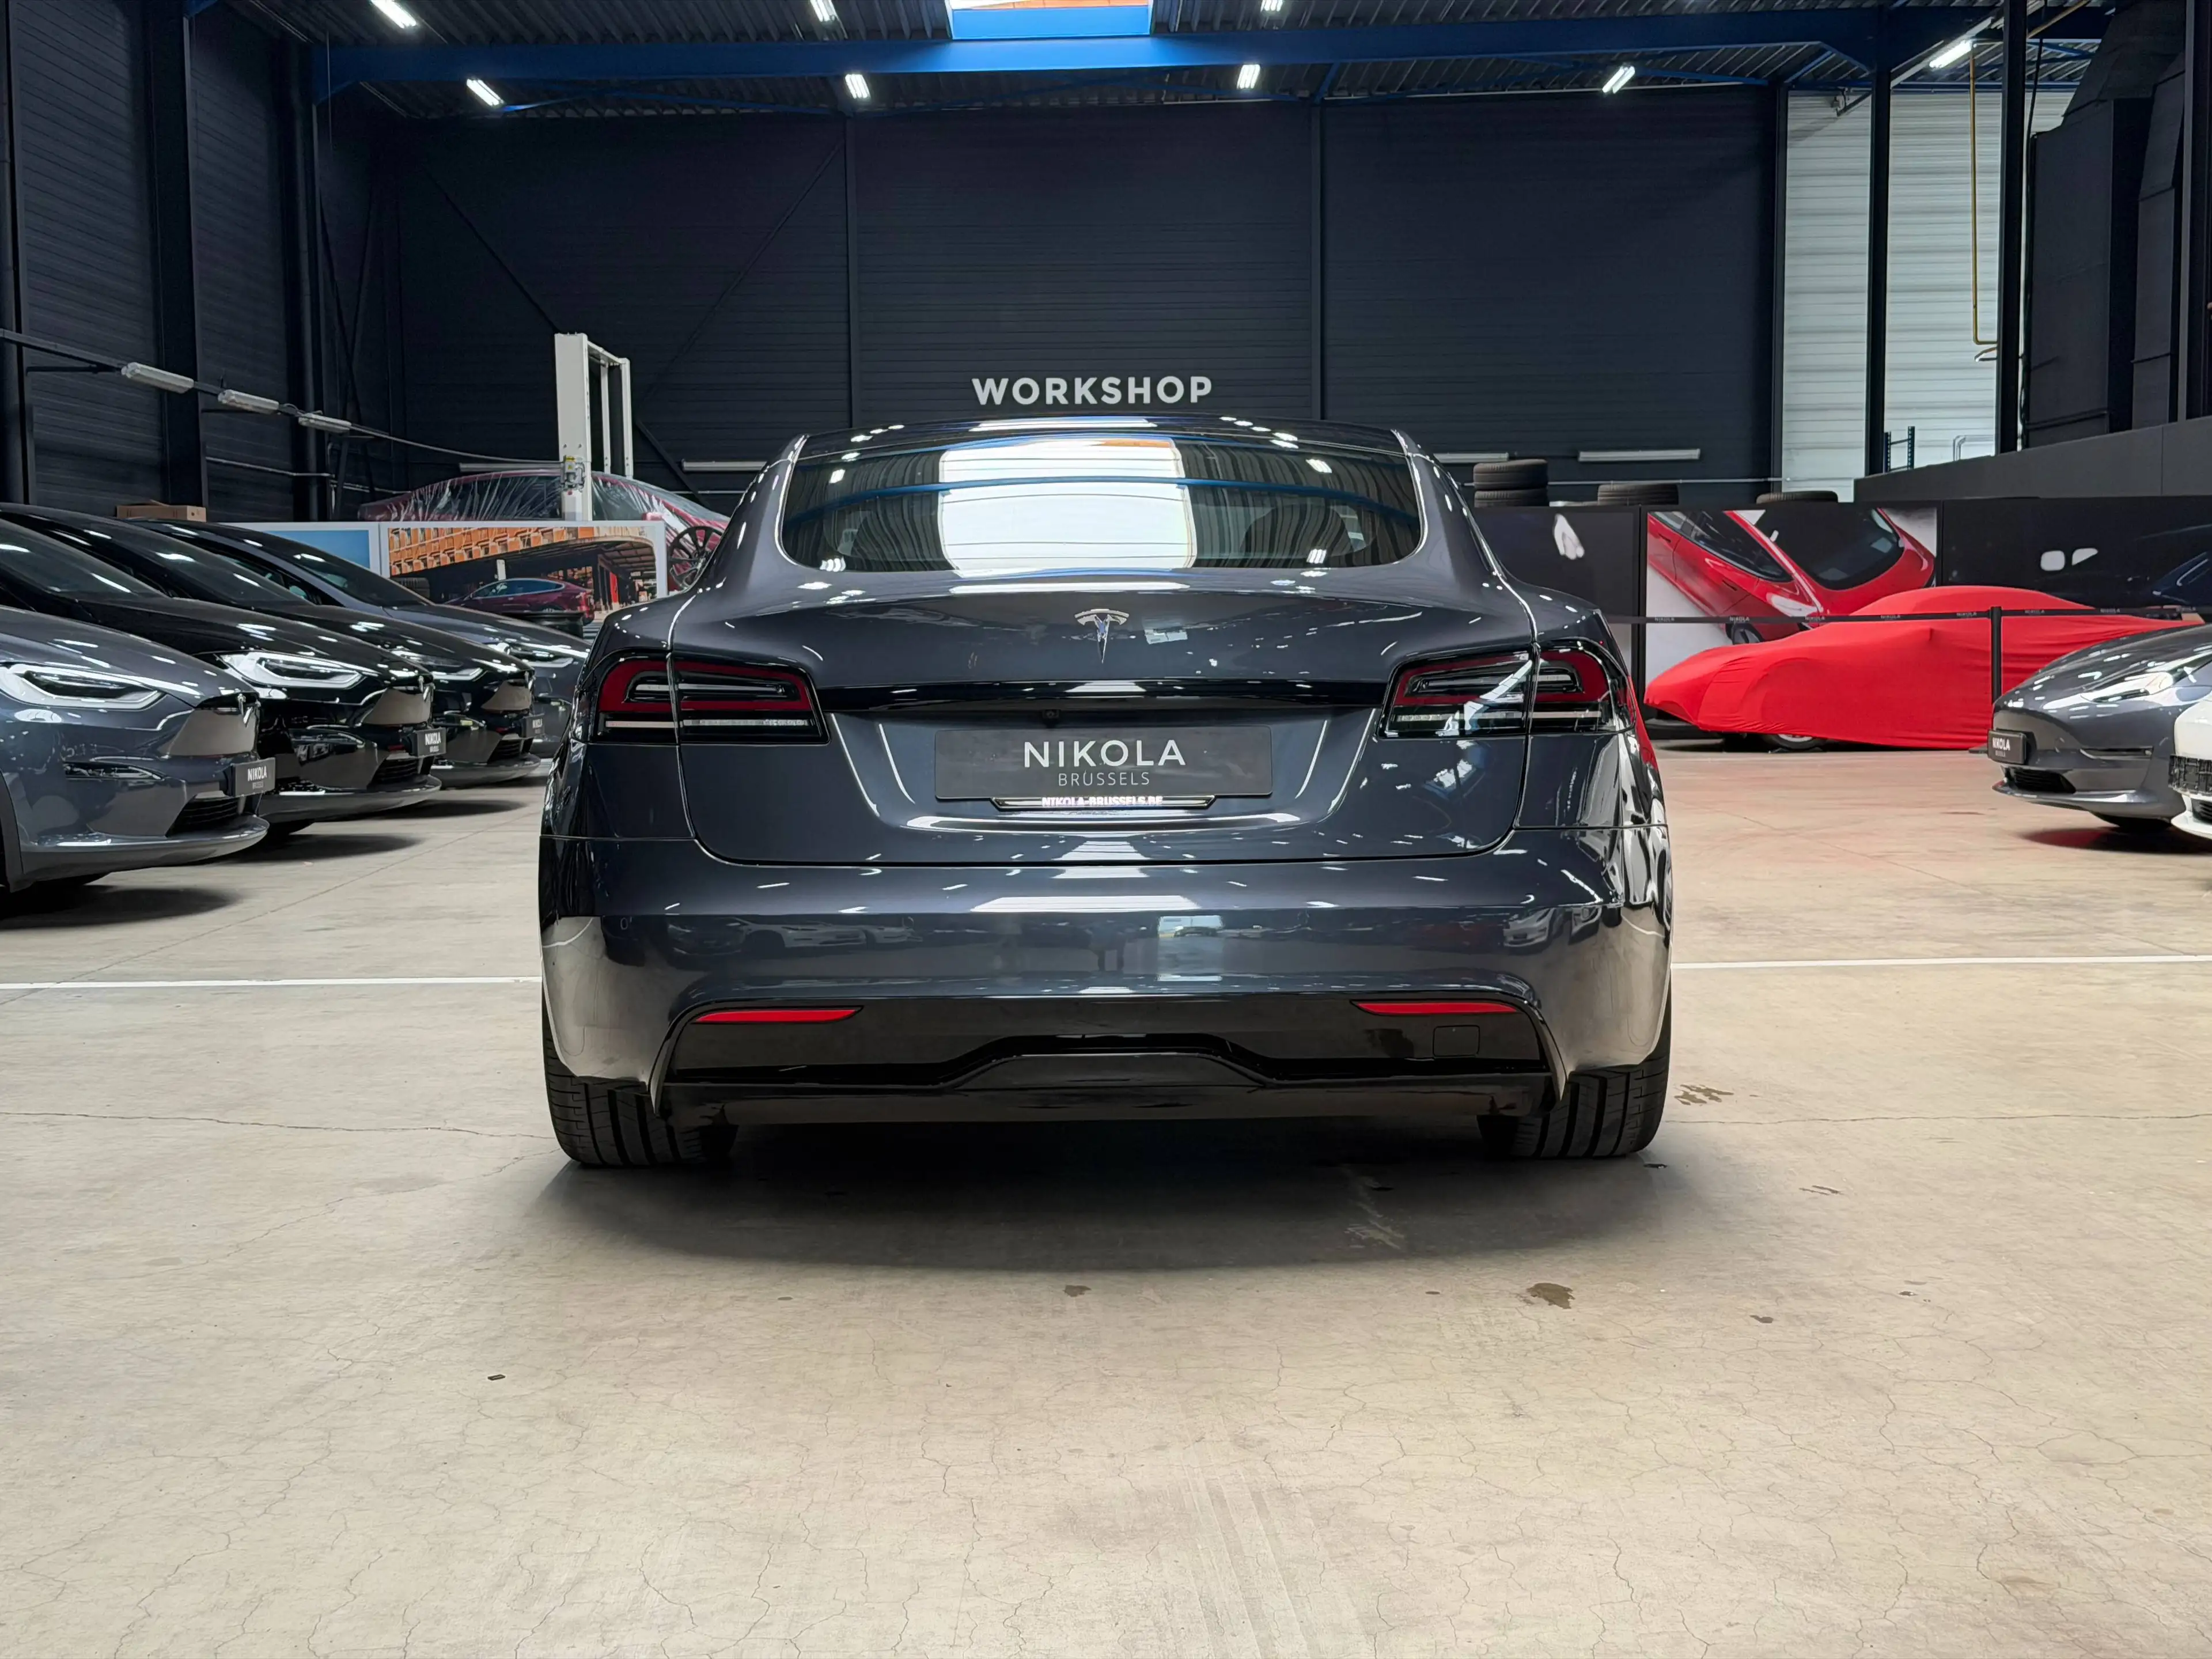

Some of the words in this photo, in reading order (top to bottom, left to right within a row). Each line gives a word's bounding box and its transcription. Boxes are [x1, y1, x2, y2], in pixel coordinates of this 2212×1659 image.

[972, 376, 1212, 405] WORKSHOP
[1024, 740, 1186, 768] NIKOLA
[247, 765, 267, 782] NIKOLA
[1058, 771, 1150, 787] BRUSSELS
[1041, 796, 1164, 806] NIKOLA-BRUSSELS.BE
